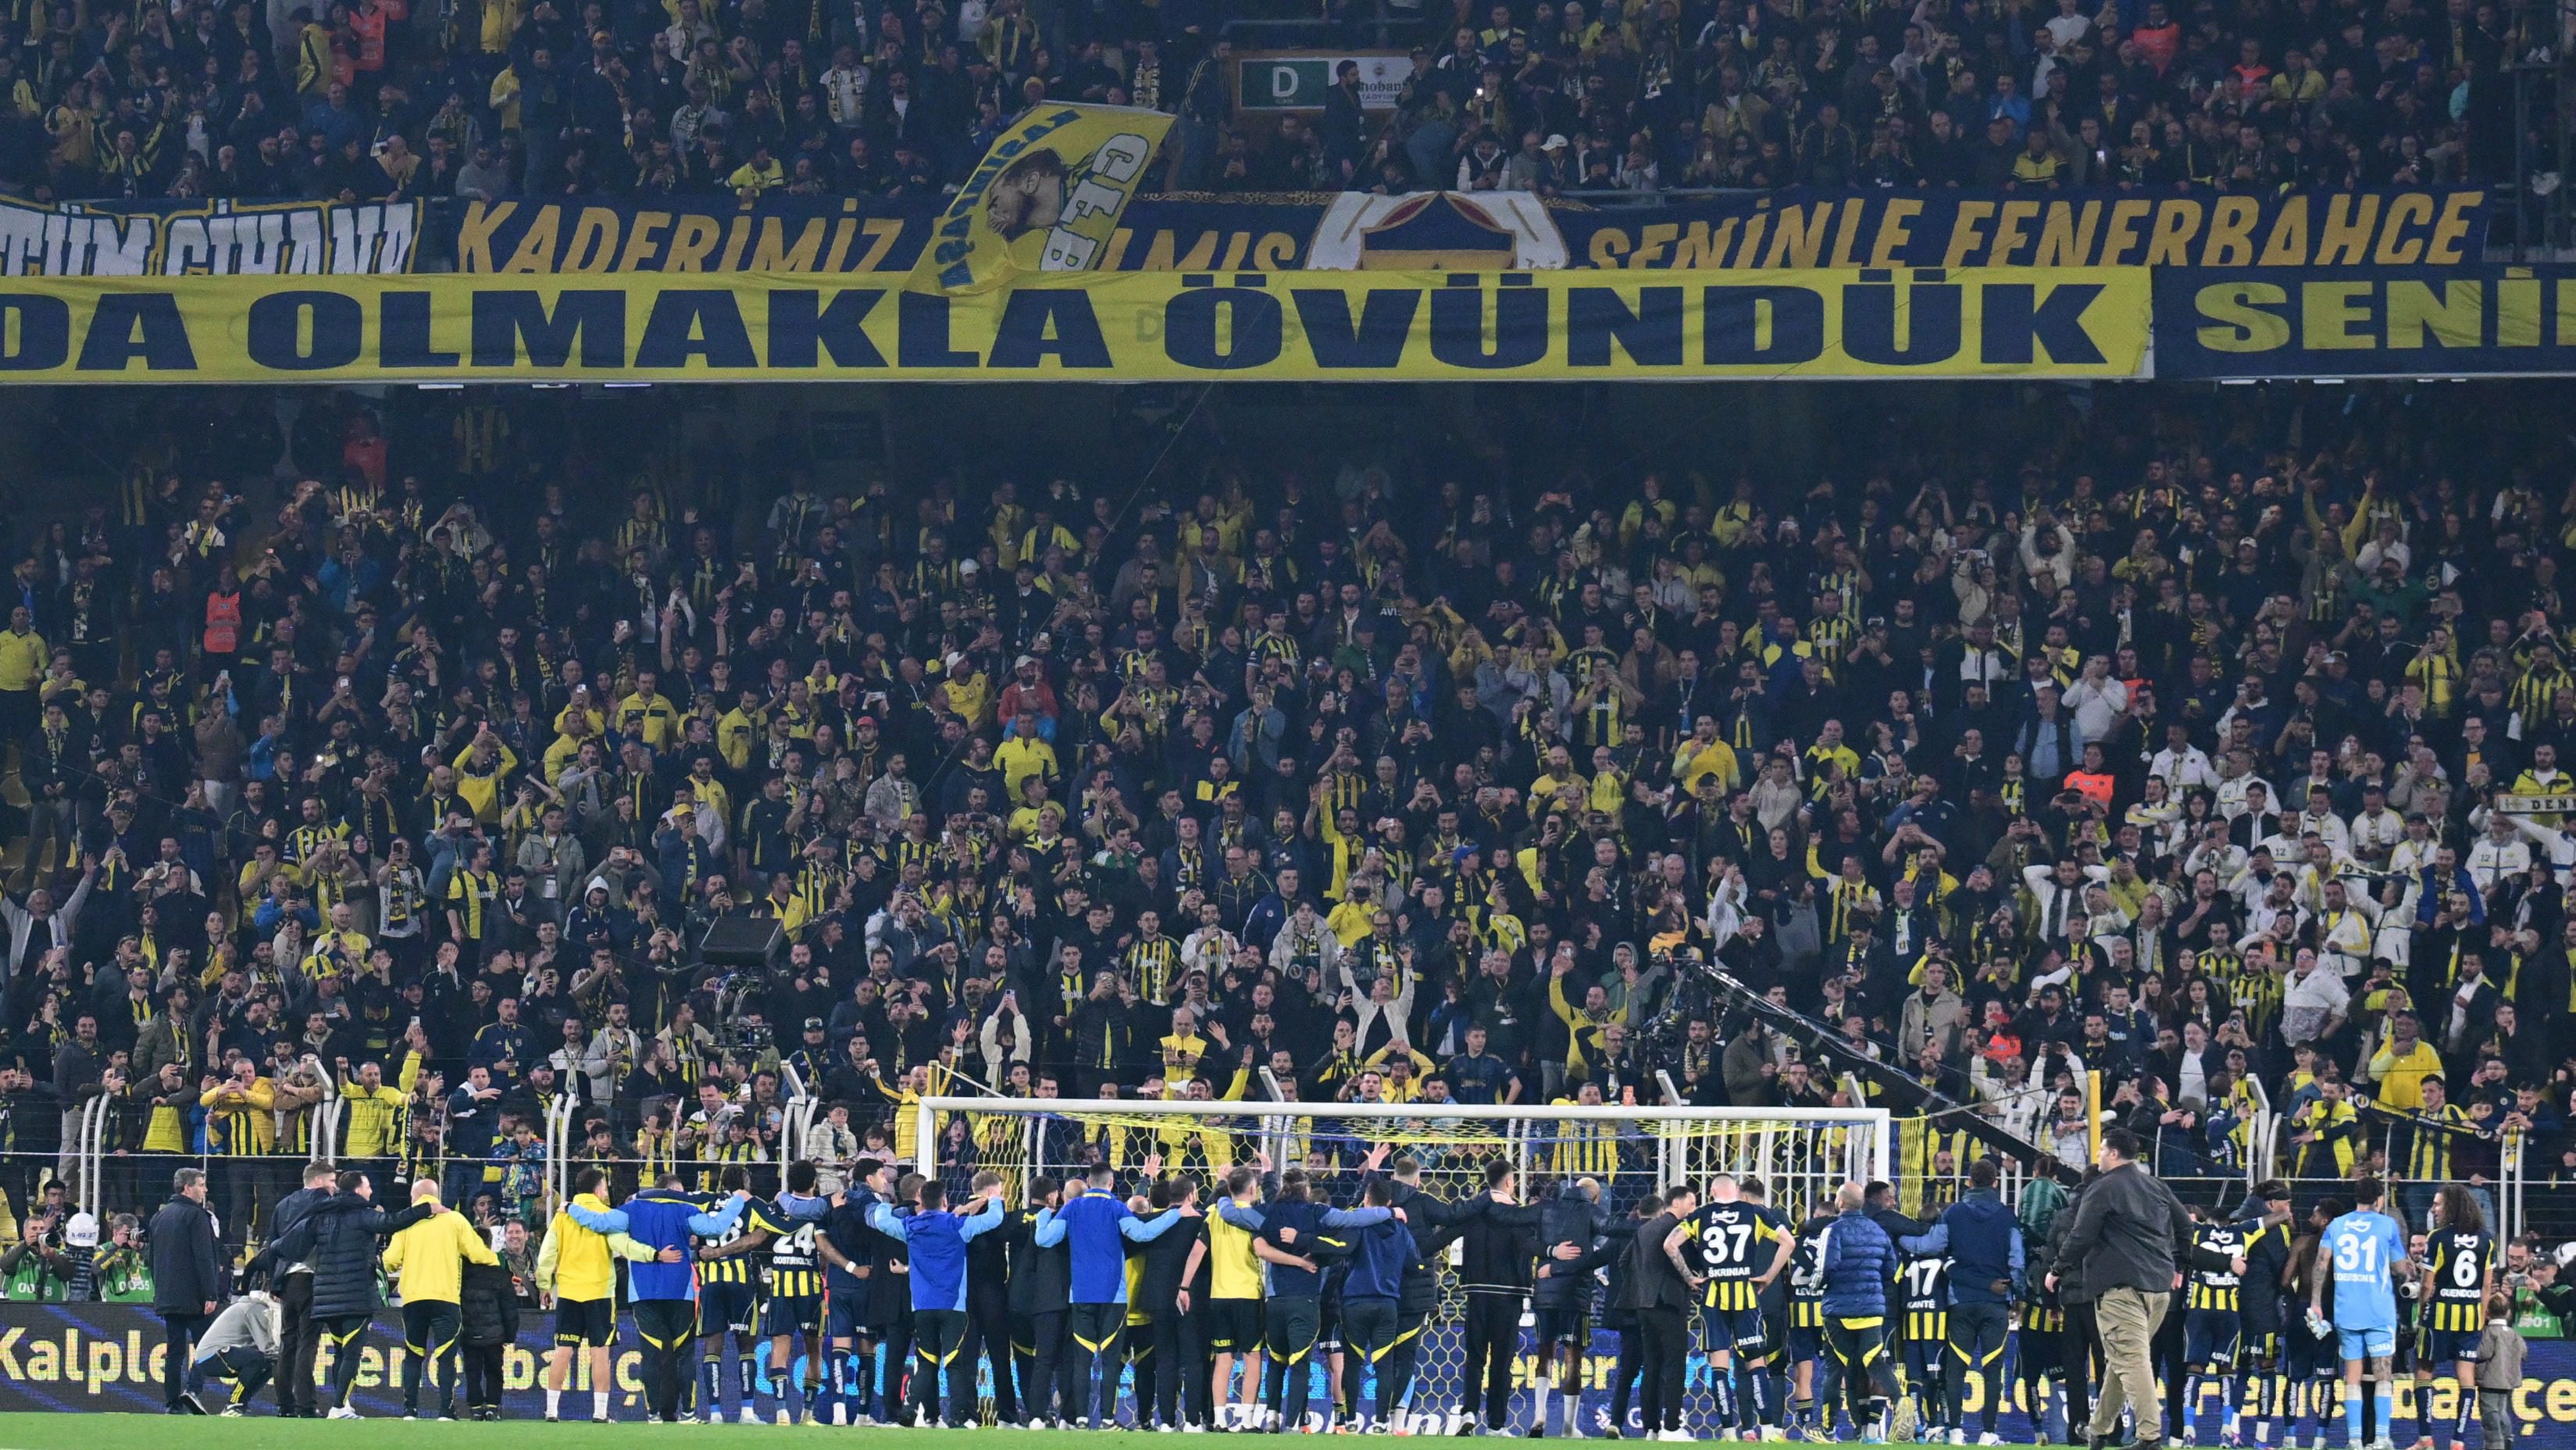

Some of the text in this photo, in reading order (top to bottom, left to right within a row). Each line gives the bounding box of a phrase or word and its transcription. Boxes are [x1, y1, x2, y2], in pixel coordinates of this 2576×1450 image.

[1272, 66, 1298, 97] D
[458, 198, 904, 273] KADERİMİZ
[247, 290, 1114, 371] OLMAKLA
[1165, 269, 2108, 370] ÖVÜNDÜK
[773, 1223, 815, 1255] 24
[1703, 1225, 1753, 1263] 37
[2336, 1234, 2377, 1271] 31
[1708, 1267, 1750, 1277] ŠKRINIAR
[1905, 1259, 1943, 1297] 17
[2453, 1249, 2477, 1287] 6
[18, 1283, 52, 1297] 008
[1795, 1288, 1825, 1296] LEVEN
[1738, 1335, 1763, 1346] PASHA
